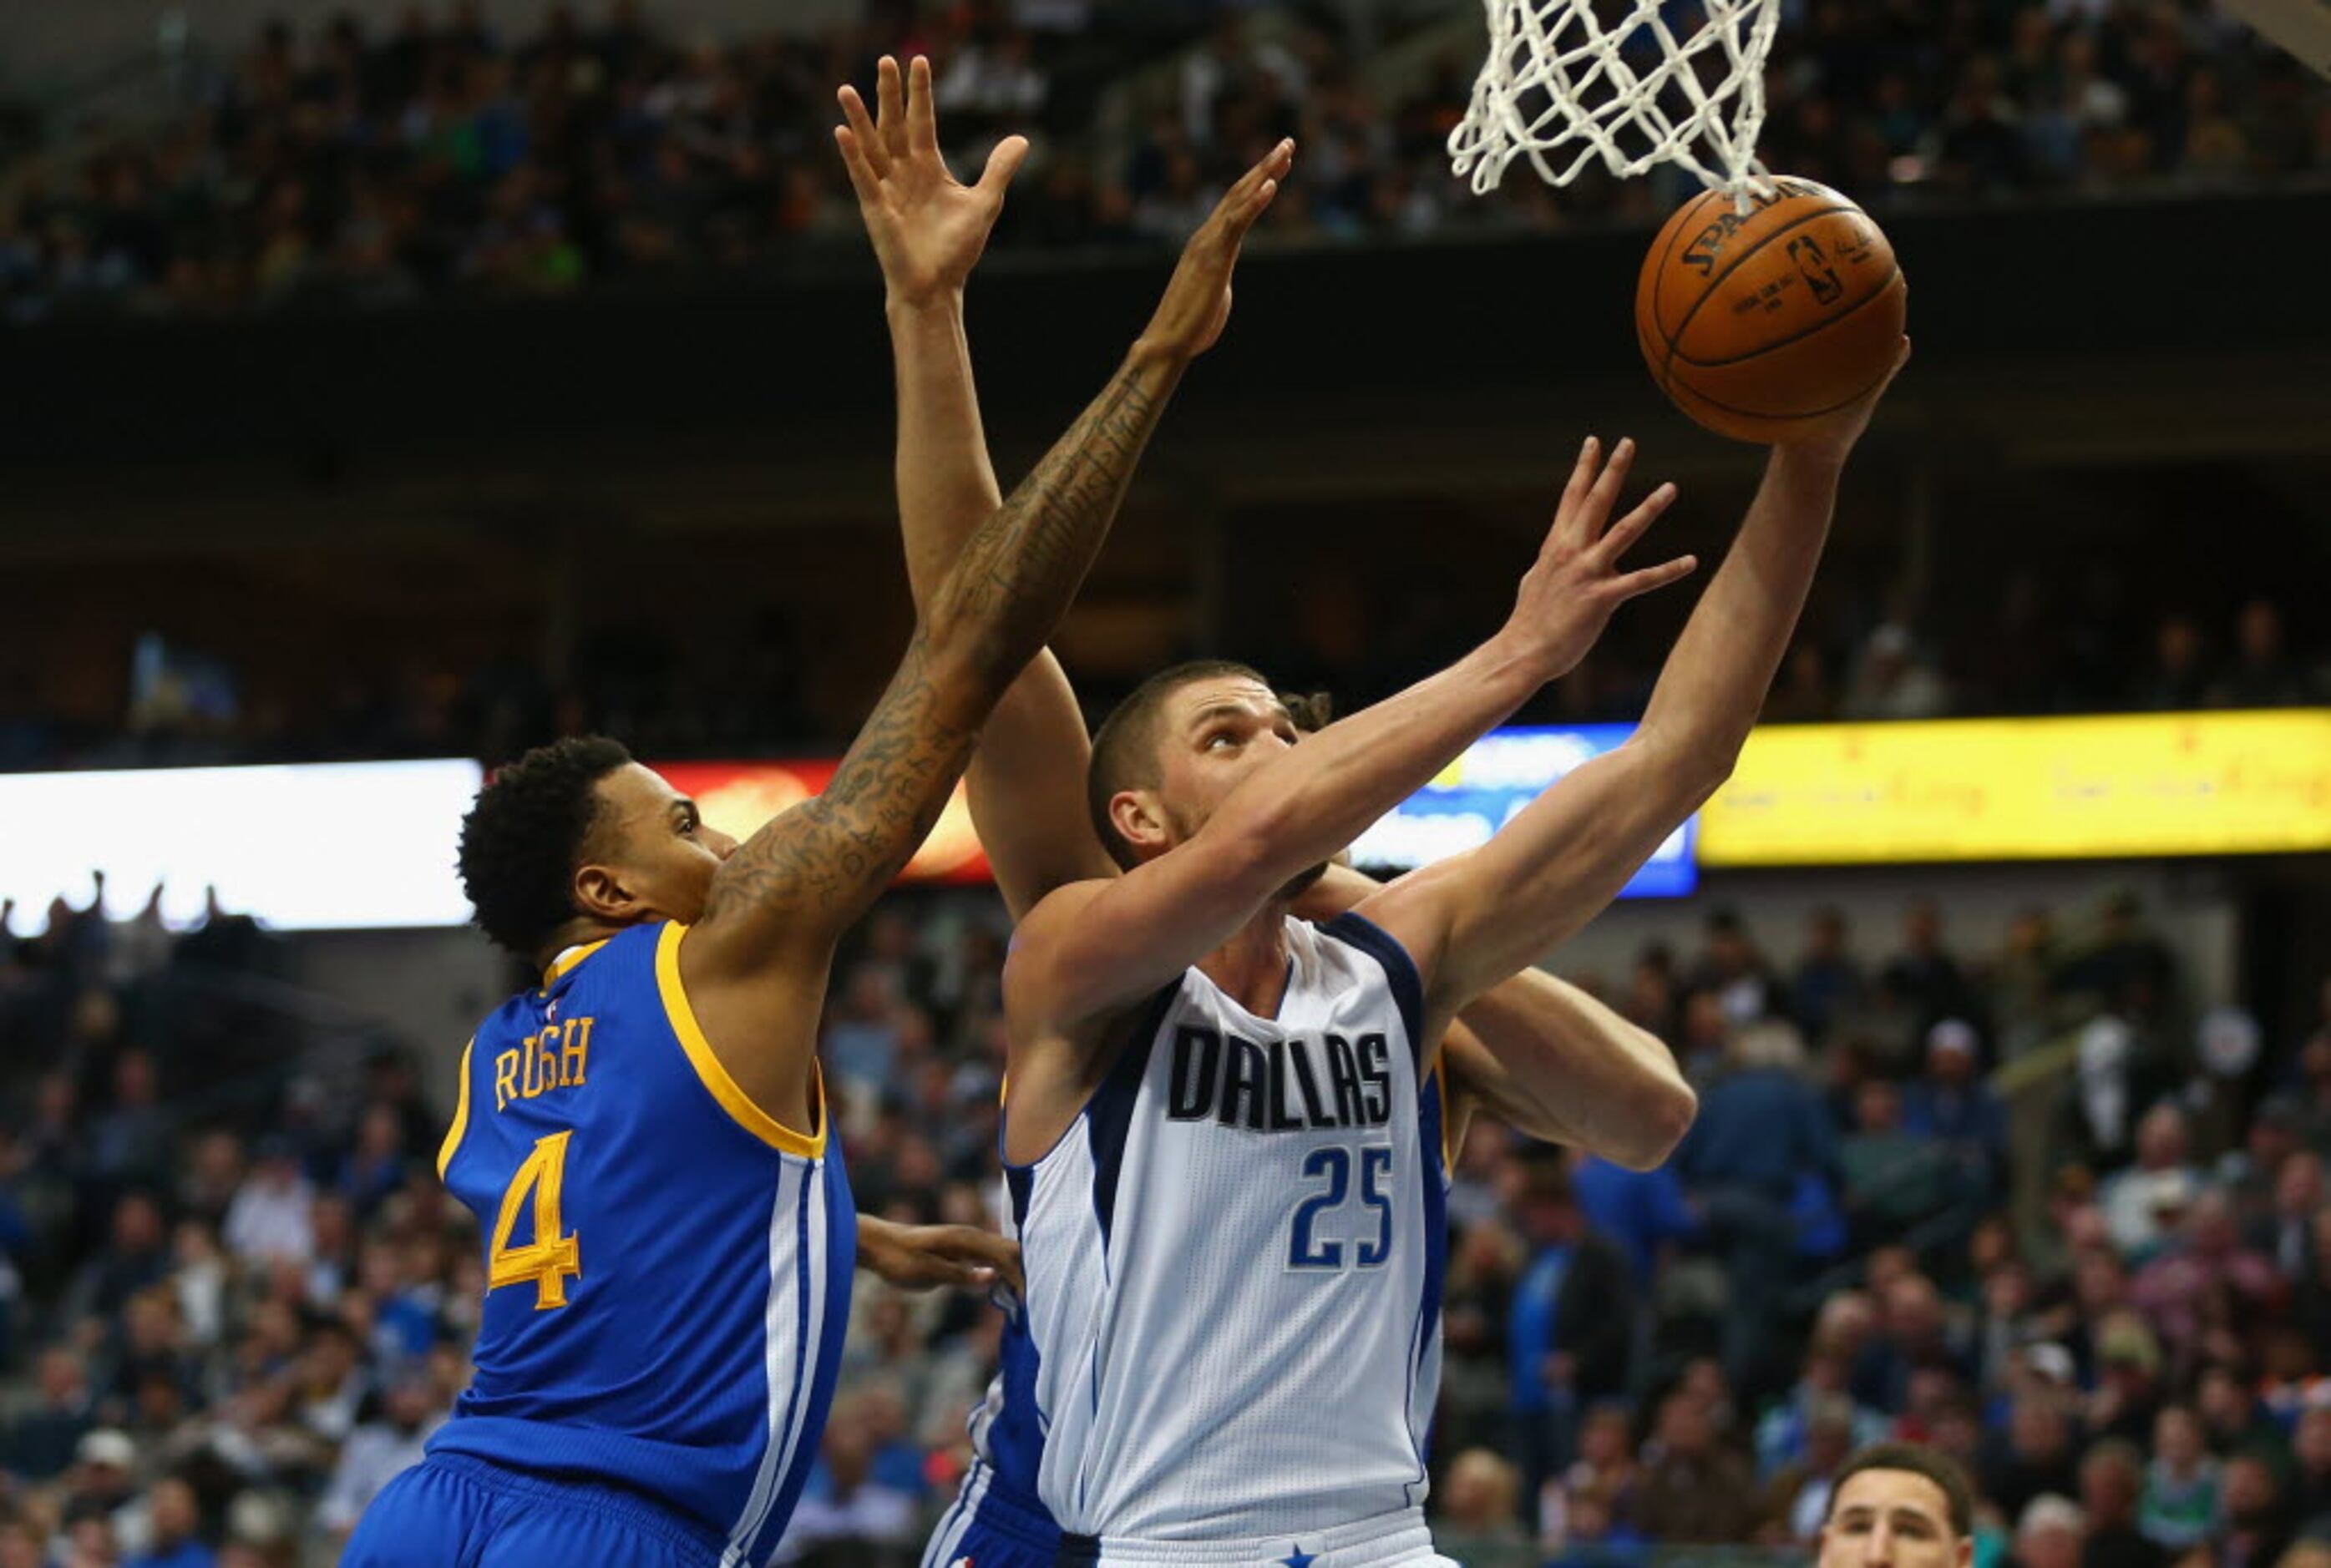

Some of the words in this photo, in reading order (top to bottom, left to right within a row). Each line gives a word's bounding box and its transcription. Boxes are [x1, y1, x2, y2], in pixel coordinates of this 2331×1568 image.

[495, 1016, 594, 1112] RUSH
[1167, 1024, 1392, 1132] DALLAS
[488, 1130, 580, 1310] 4
[1285, 1143, 1393, 1273] 25
